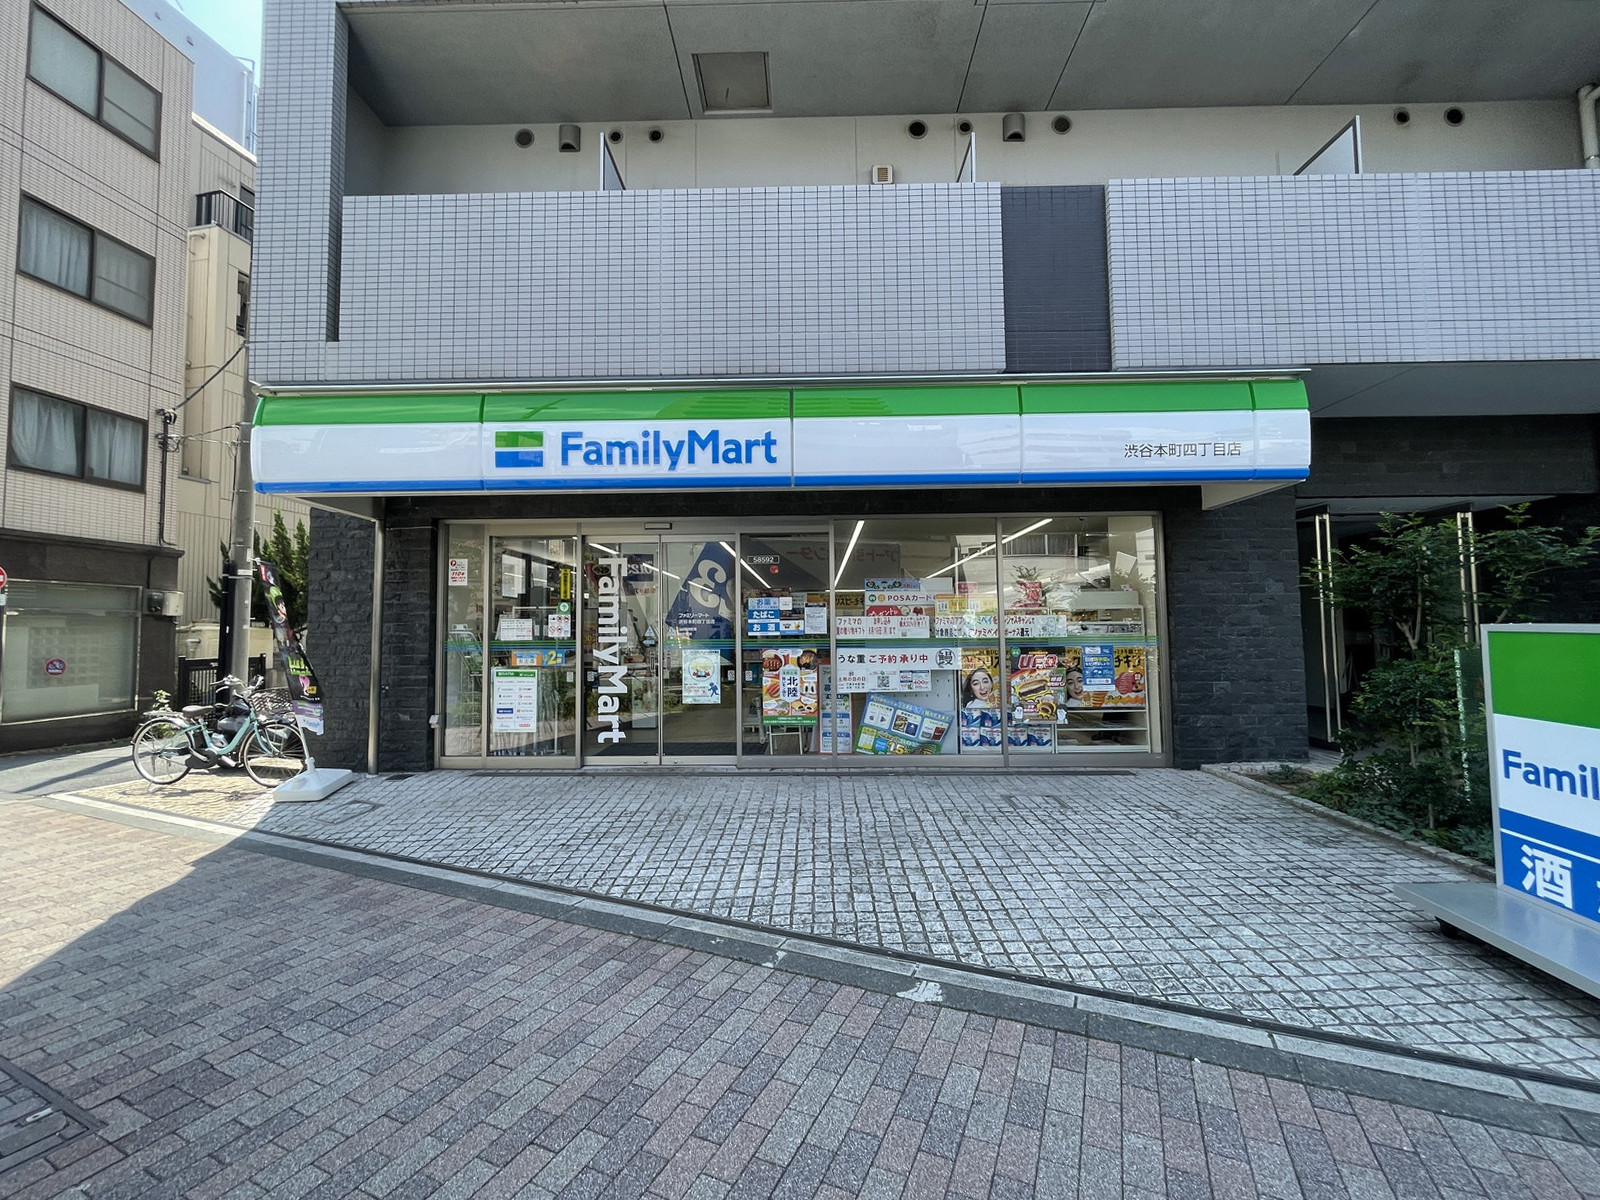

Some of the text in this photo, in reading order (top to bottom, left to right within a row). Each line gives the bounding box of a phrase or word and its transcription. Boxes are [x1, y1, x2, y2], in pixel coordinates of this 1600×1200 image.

[561, 429, 777, 471] FamilyMart
[1124, 442, 1242, 458] 渋谷本町四丁目店
[887, 594, 932, 602] POSAカード
[752, 611, 775, 619] たばこ
[592, 557, 628, 744] FamilyMart
[838, 654, 928, 664] うな重 ご予約 承り中
[786, 676, 798, 698] 北陸
[1520, 844, 1573, 909] 酒
